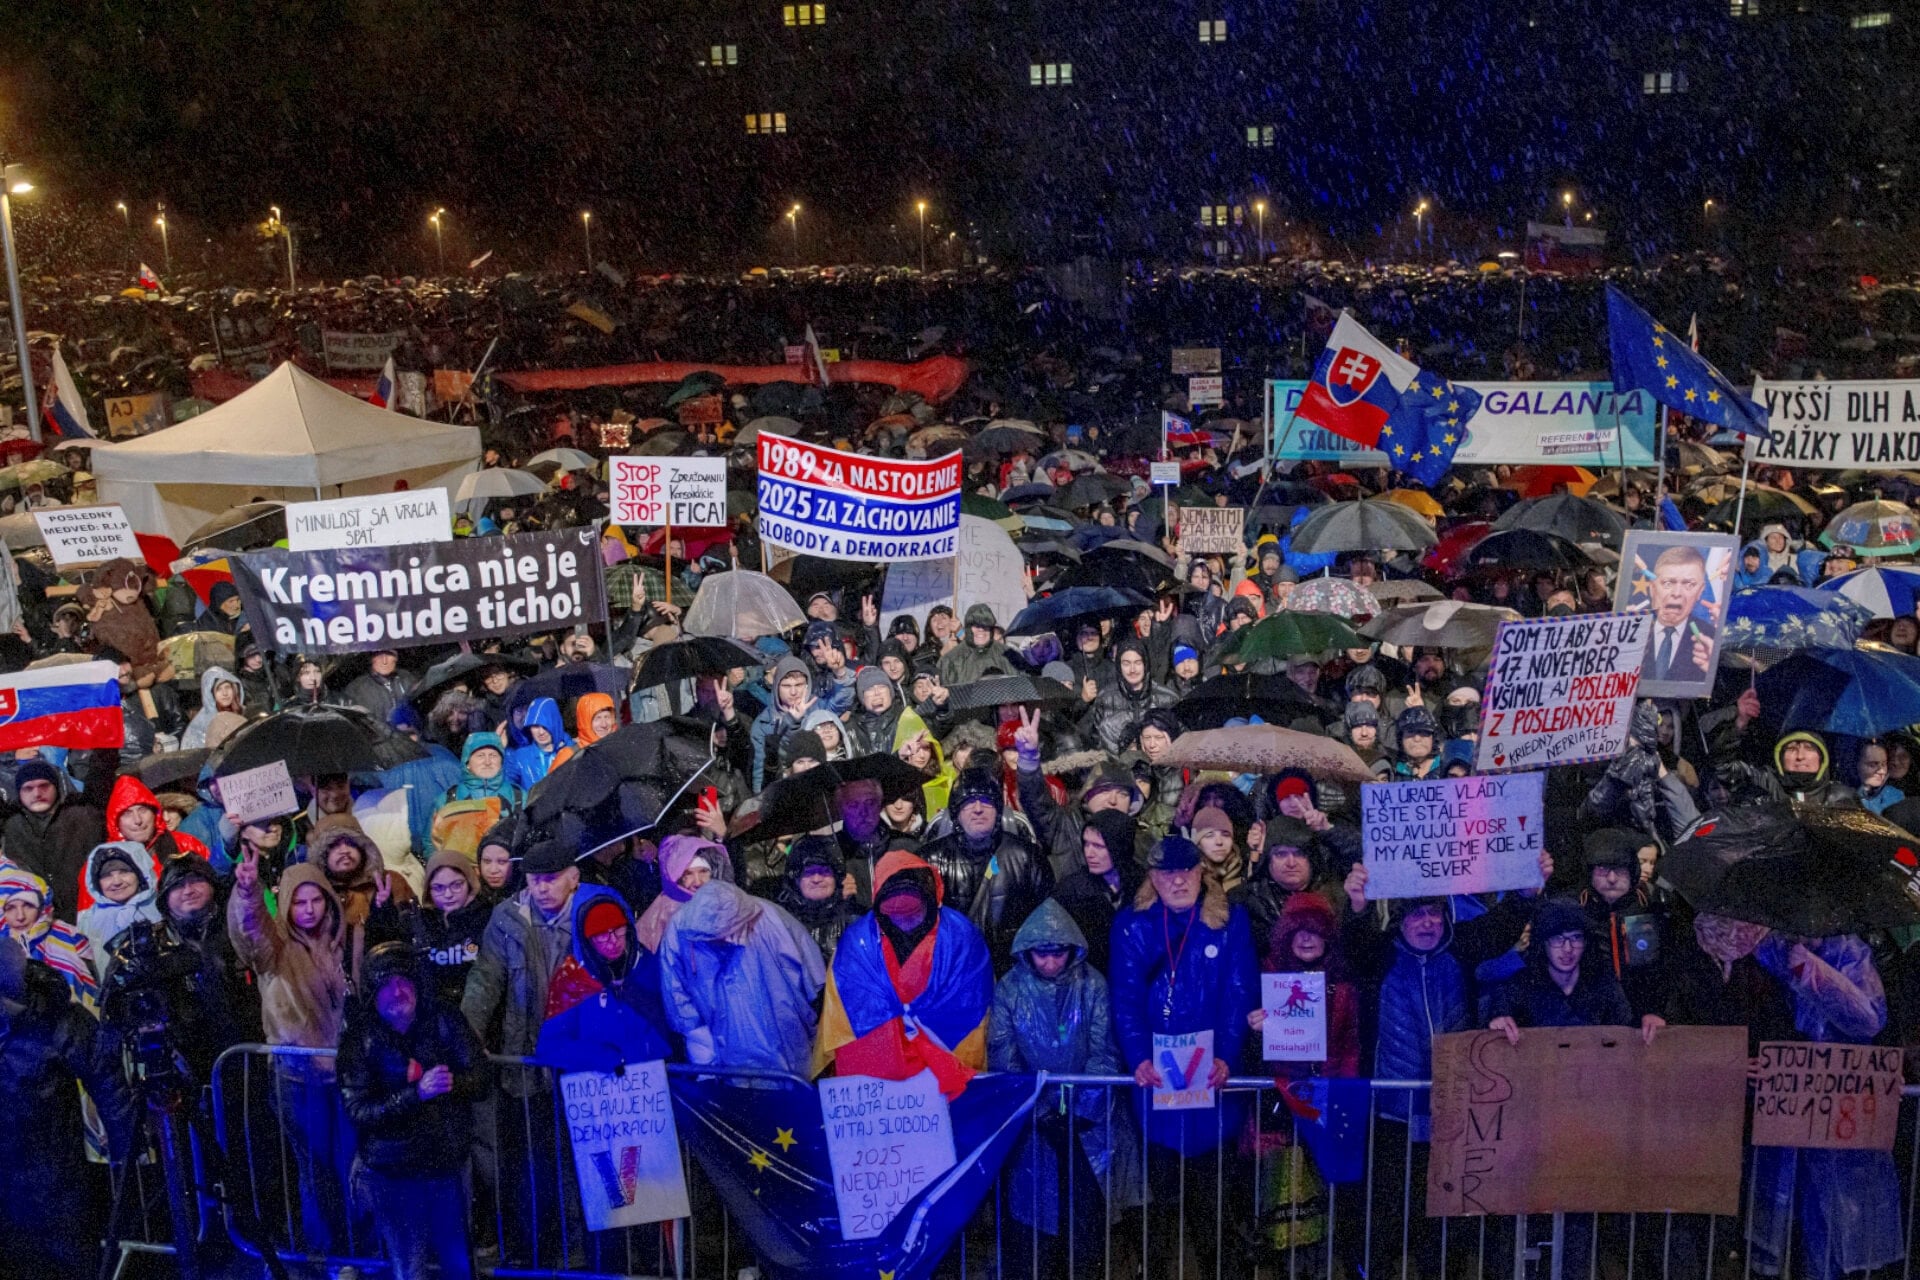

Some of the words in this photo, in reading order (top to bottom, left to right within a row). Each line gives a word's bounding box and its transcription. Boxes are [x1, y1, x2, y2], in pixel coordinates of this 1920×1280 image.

[1485, 391, 1644, 415] GALANTA
[1765, 385, 1832, 421] VYŠŠÍ
[1847, 391, 1889, 422] DLH
[1902, 390, 1920, 422] A
[1541, 431, 1611, 444] REFERENDUM
[1755, 424, 1841, 461] ZRÁŽKY
[616, 462, 661, 482] STOP
[762, 441, 817, 480] 1989
[822, 460, 844, 484] ZA
[850, 463, 958, 496] NASTOLENIE
[617, 484, 661, 501] STOP
[759, 480, 812, 519] 2025
[815, 498, 837, 524] ZA
[370, 507, 389, 526] SA
[396, 501, 438, 520] VRACIA
[617, 502, 662, 522] STOP
[675, 502, 725, 524] FICA!
[91, 535, 123, 545] BUDE
[759, 517, 829, 552] SLOBODY
[831, 539, 840, 554] A
[845, 535, 955, 558] DEMOKRACIE
[261, 557, 470, 604] Kremnica
[479, 548, 538, 588] nie
[545, 544, 577, 590] je
[275, 617, 297, 644] a
[305, 598, 467, 645] nebude
[478, 582, 582, 630] ticho!
[1501, 627, 1540, 654] SOM
[1545, 625, 1562, 652] TU,
[1565, 621, 1596, 649] ABY
[1595, 622, 1613, 645] SI
[1617, 617, 1643, 643] UŽ
[1497, 656, 1523, 683] 17.
[1527, 646, 1620, 680] NOVEMBER
[1491, 682, 1544, 710] VŠIMOL
[1550, 679, 1569, 698] AJ
[1568, 666, 1640, 703] POSLEDNÝ
[1488, 713, 1506, 737] Z
[1512, 700, 1618, 735] POSLEDNÝCH.
[1585, 737, 1622, 755] VLÁDY
[1372, 789, 1392, 805] NA
[1399, 784, 1445, 802] ÚRADE
[1455, 778, 1508, 799] VLÁDY
[1366, 803, 1409, 824] EŠTE
[1416, 803, 1468, 821] STÁLE
[1464, 818, 1507, 836] VOSR
[1375, 847, 1399, 862] MY
[1402, 843, 1431, 860] ALE
[1437, 839, 1479, 858] VIEME
[1486, 836, 1515, 853] KDE
[1519, 833, 1539, 850] JE
[1416, 856, 1477, 878] "SEVER"
[1840, 1048, 1863, 1070] TU
[1867, 1048, 1899, 1073] AKO
[1758, 1073, 1798, 1093] MOJI
[1883, 1077, 1896, 1096] V
[568, 1091, 667, 1121] OSLAVUJEME
[828, 1099, 882, 1120] JEDNOTA
[1755, 1096, 1798, 1116] ROKU
[1801, 1096, 1877, 1141] 1989
[572, 1118, 666, 1144] DEMOKRACIU
[878, 1113, 940, 1136] SLOBODA
[852, 1144, 905, 1168] 2025
[841, 1166, 926, 1193] NEDAJME
[862, 1193, 879, 1209] SI
[885, 1187, 911, 1209] JU
